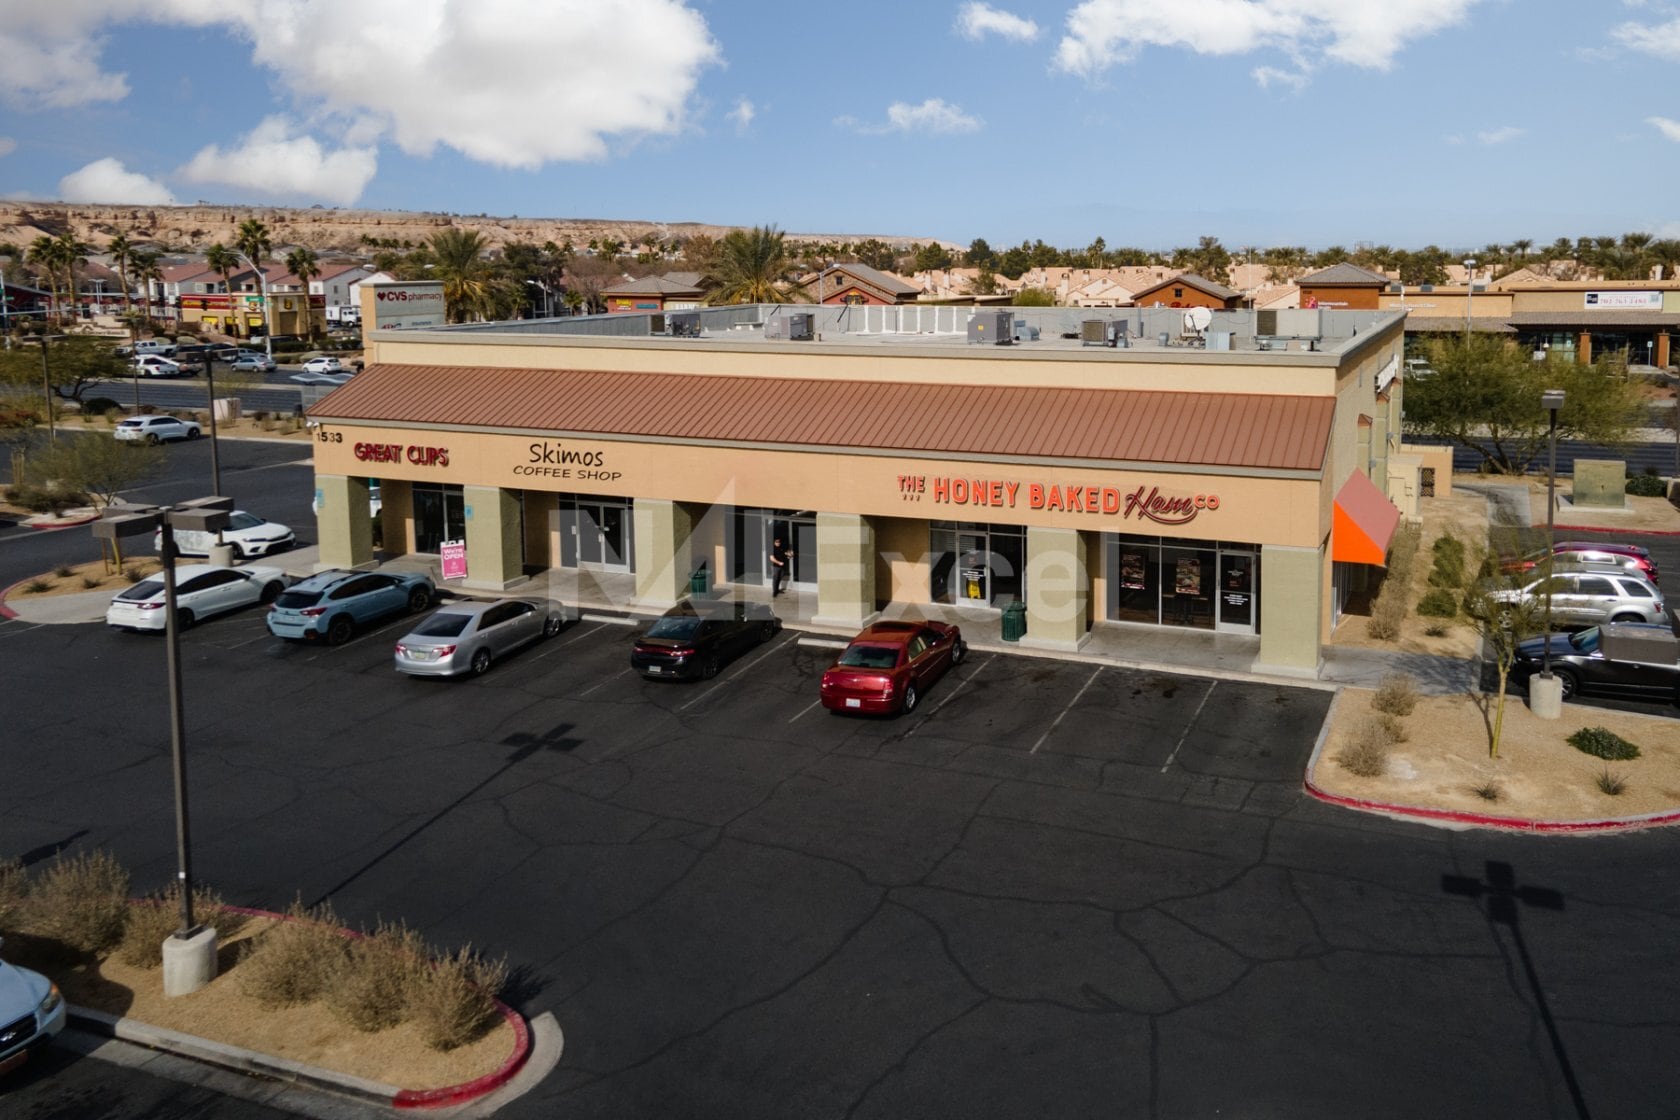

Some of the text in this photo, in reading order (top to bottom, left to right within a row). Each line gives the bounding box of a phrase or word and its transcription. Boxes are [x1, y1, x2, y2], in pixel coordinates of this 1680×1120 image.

[387, 291, 442, 303] CVS pharmacy
[316, 431, 343, 443] 1533
[354, 442, 449, 467] GREAT CLIPS
[529, 441, 604, 467] Skimos
[512, 465, 622, 481] COFFEE SHOP
[897, 475, 1220, 524] THE HONEY BAKED Ham CO
